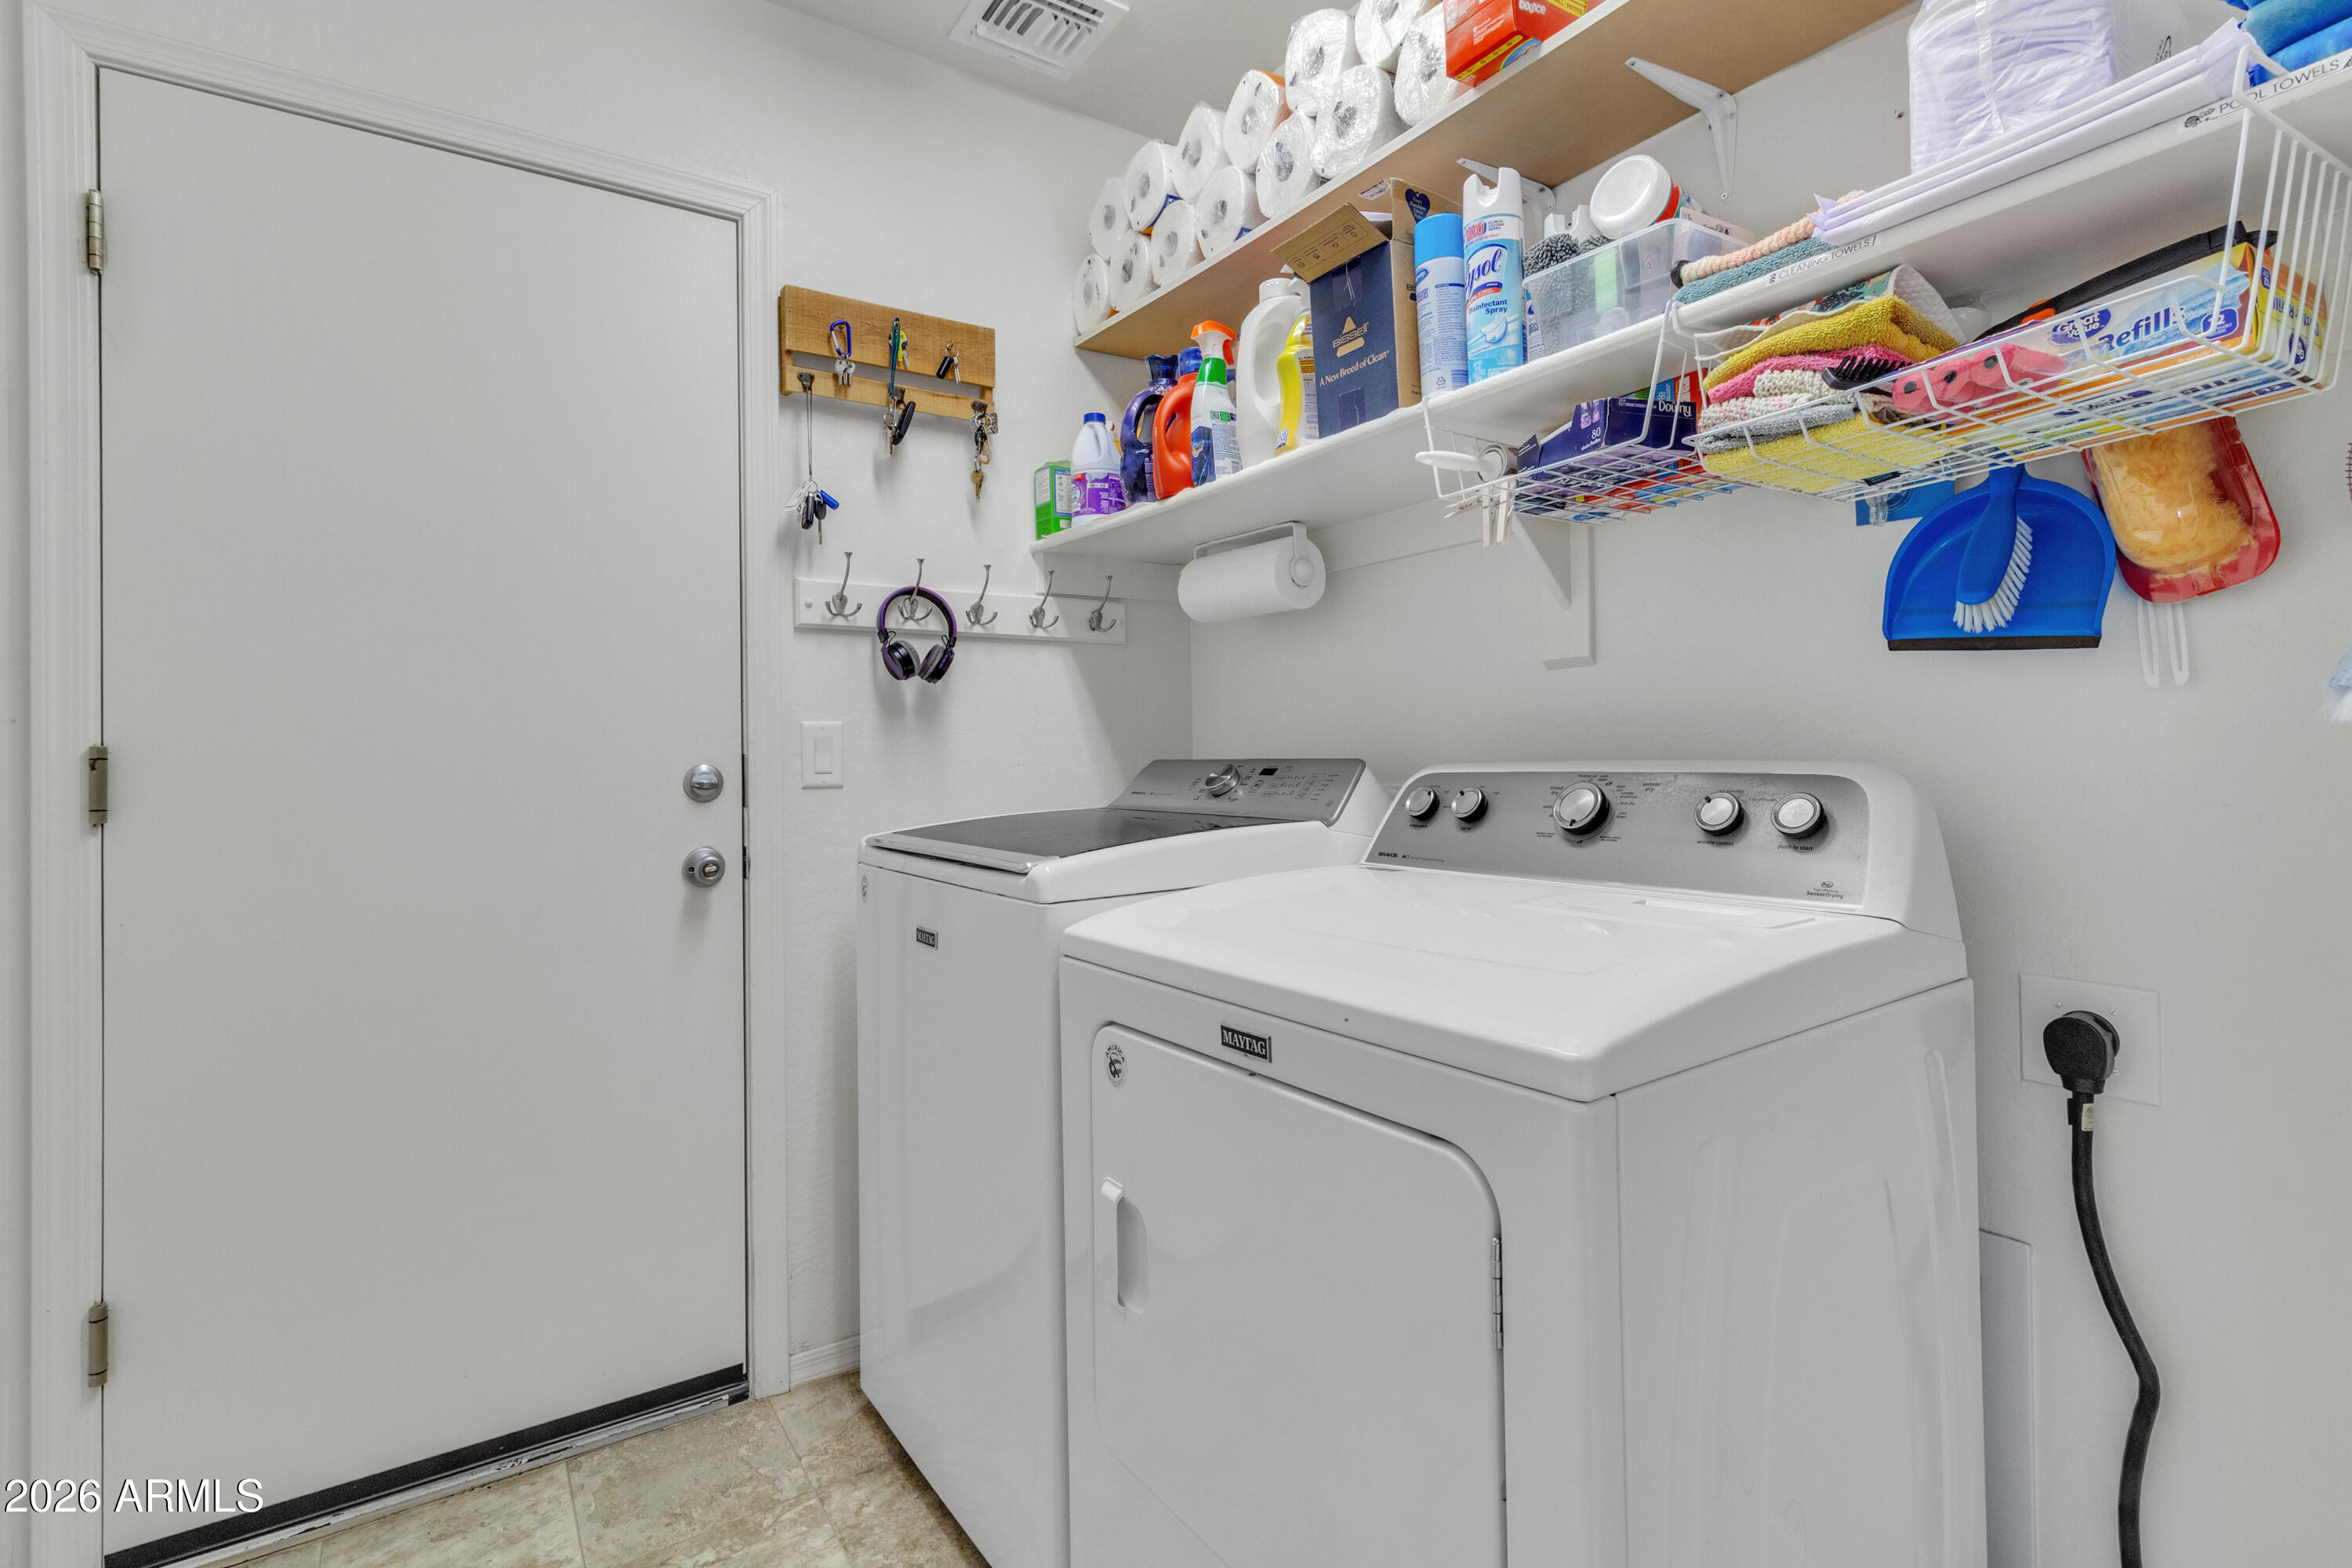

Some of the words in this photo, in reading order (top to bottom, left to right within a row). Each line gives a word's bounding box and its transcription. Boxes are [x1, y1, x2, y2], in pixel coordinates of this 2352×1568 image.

[1519, 0, 1546, 15] bounce
[2272, 60, 2339, 93] TOWELS
[1465, 221, 1486, 243] 100
[1779, 257, 1828, 279] CLEANING
[1831, 239, 1870, 260] TOWELS
[1468, 299, 1508, 314] Disinfectant
[1485, 307, 1508, 315] Spray
[1319, 377, 1325, 387] A
[1325, 373, 1339, 384] New
[1340, 361, 1359, 378] Breed
[1359, 358, 1367, 368] of
[1367, 351, 1387, 365] Clean
[1592, 426, 1601, 440] 80
[917, 930, 935, 945] MAYTAG
[1222, 1029, 1266, 1055] MAYTAG
[1105, 1044, 1125, 1063] AMERICA
